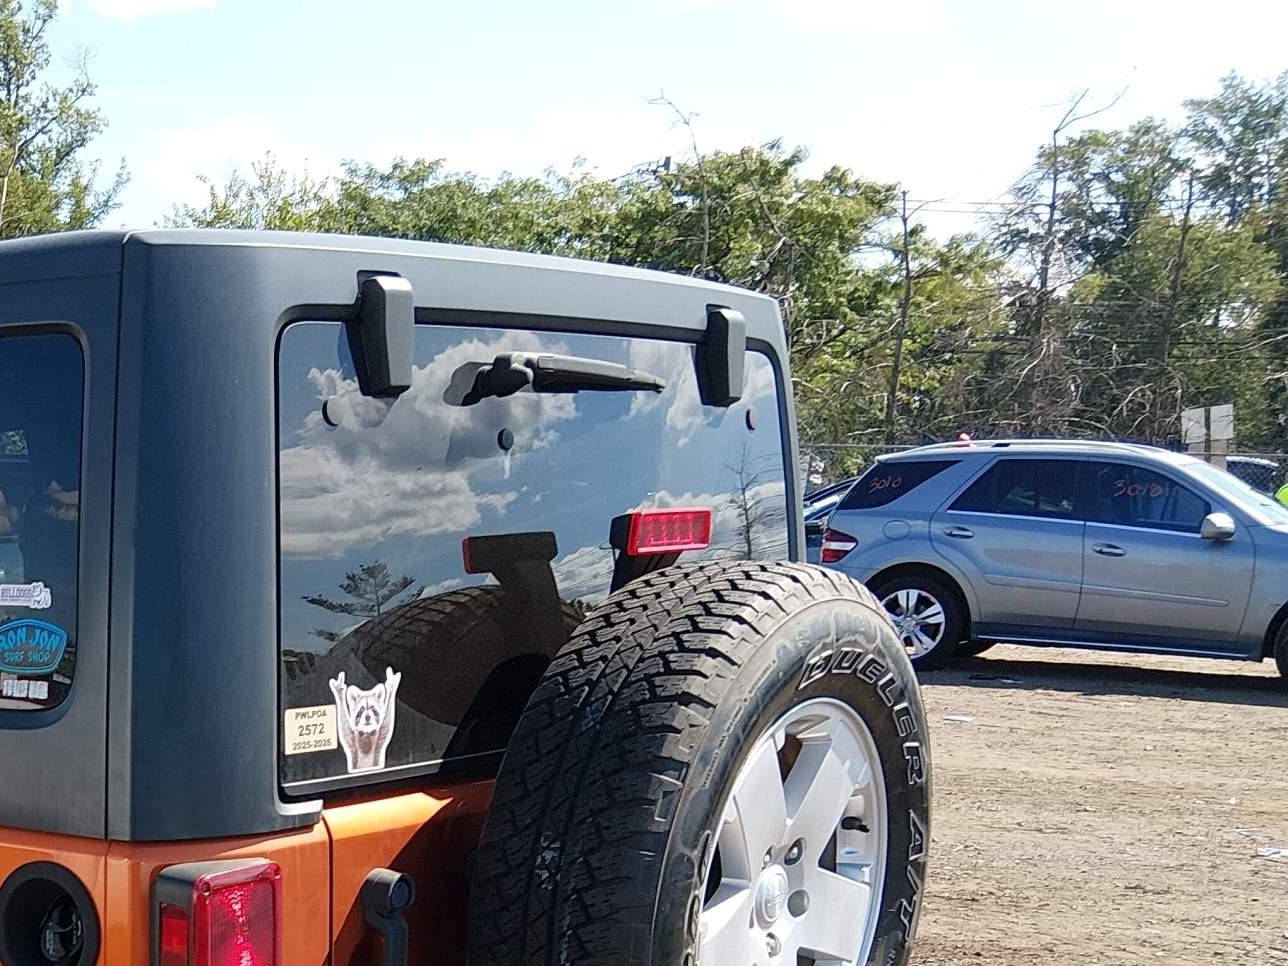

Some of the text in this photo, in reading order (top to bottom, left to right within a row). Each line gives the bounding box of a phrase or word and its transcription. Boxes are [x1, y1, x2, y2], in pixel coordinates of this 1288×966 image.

[29, 627, 61, 652] JON
[4, 650, 51, 662] SURF SHOP
[797, 646, 924, 786] DUELER
[298, 723, 326, 738] 2572
